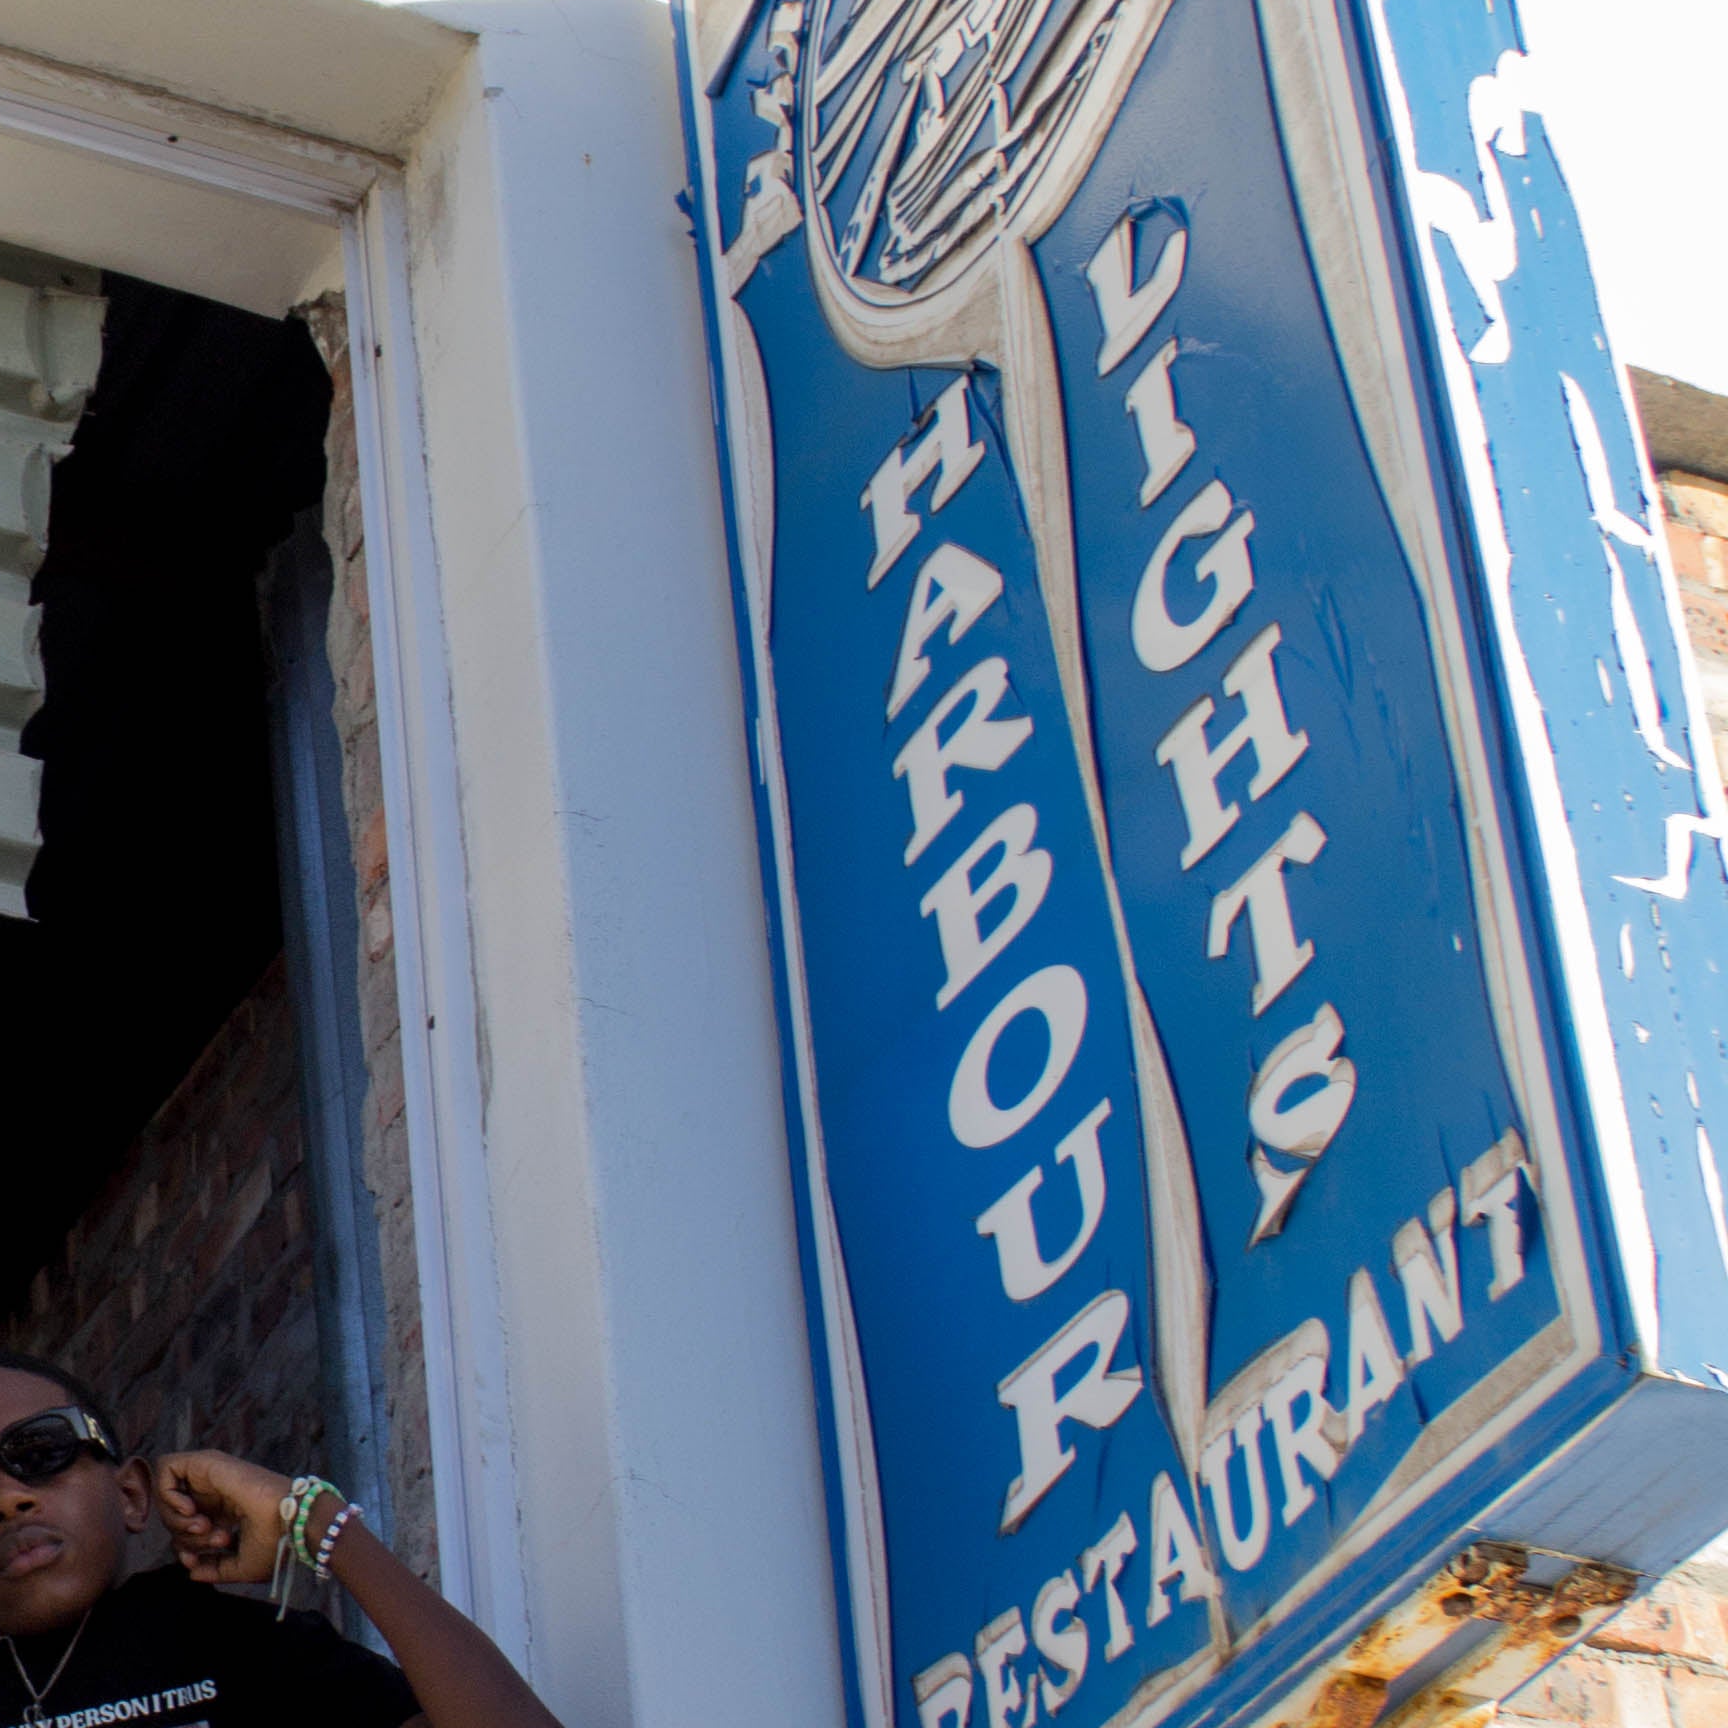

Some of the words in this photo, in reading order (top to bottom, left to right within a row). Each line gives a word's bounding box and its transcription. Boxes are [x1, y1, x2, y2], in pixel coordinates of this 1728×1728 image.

[858, 370, 1143, 1538] HARBOUR
[1087, 194, 1358, 1250] LIGHTS
[151, 1693, 162, 1713] I
[161, 1679, 218, 1710] TRUS
